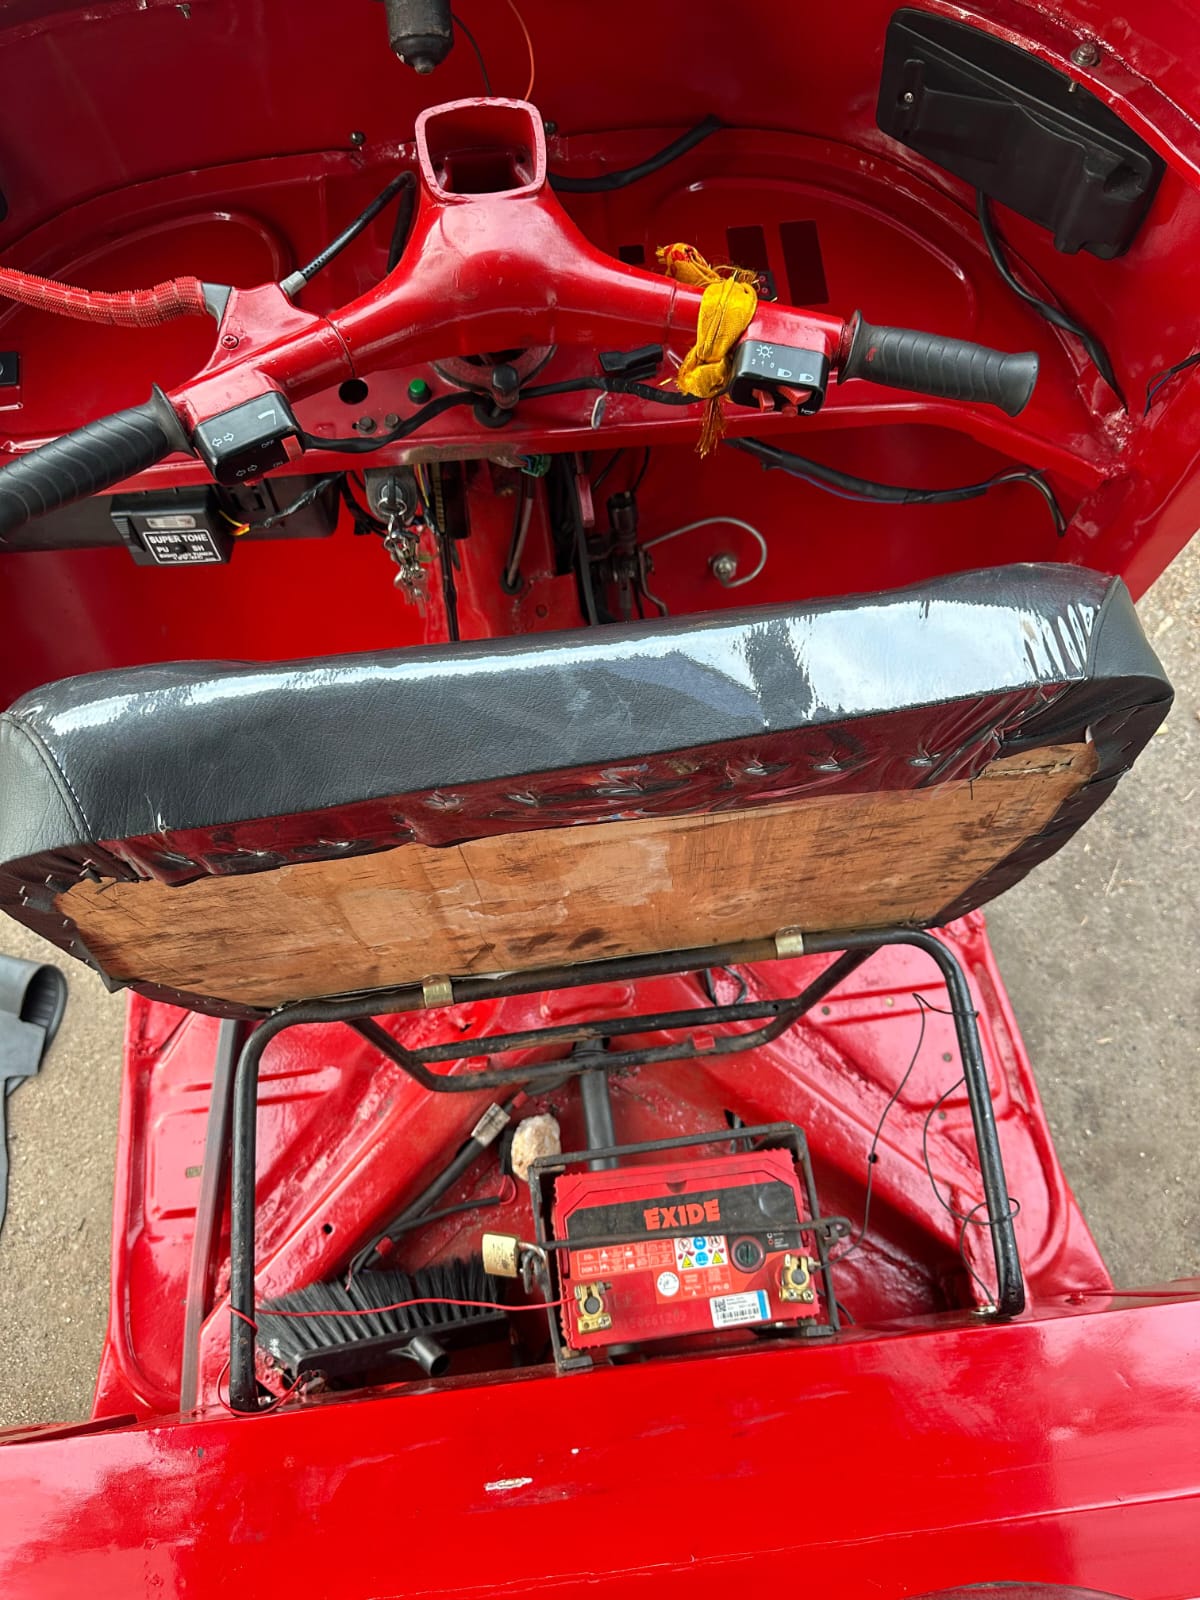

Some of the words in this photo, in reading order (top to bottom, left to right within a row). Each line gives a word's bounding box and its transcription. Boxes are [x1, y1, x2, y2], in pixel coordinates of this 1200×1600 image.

[148, 534, 182, 544] SUPER
[181, 533, 209, 542] TONE
[643, 1199, 721, 1232] EXIDE
